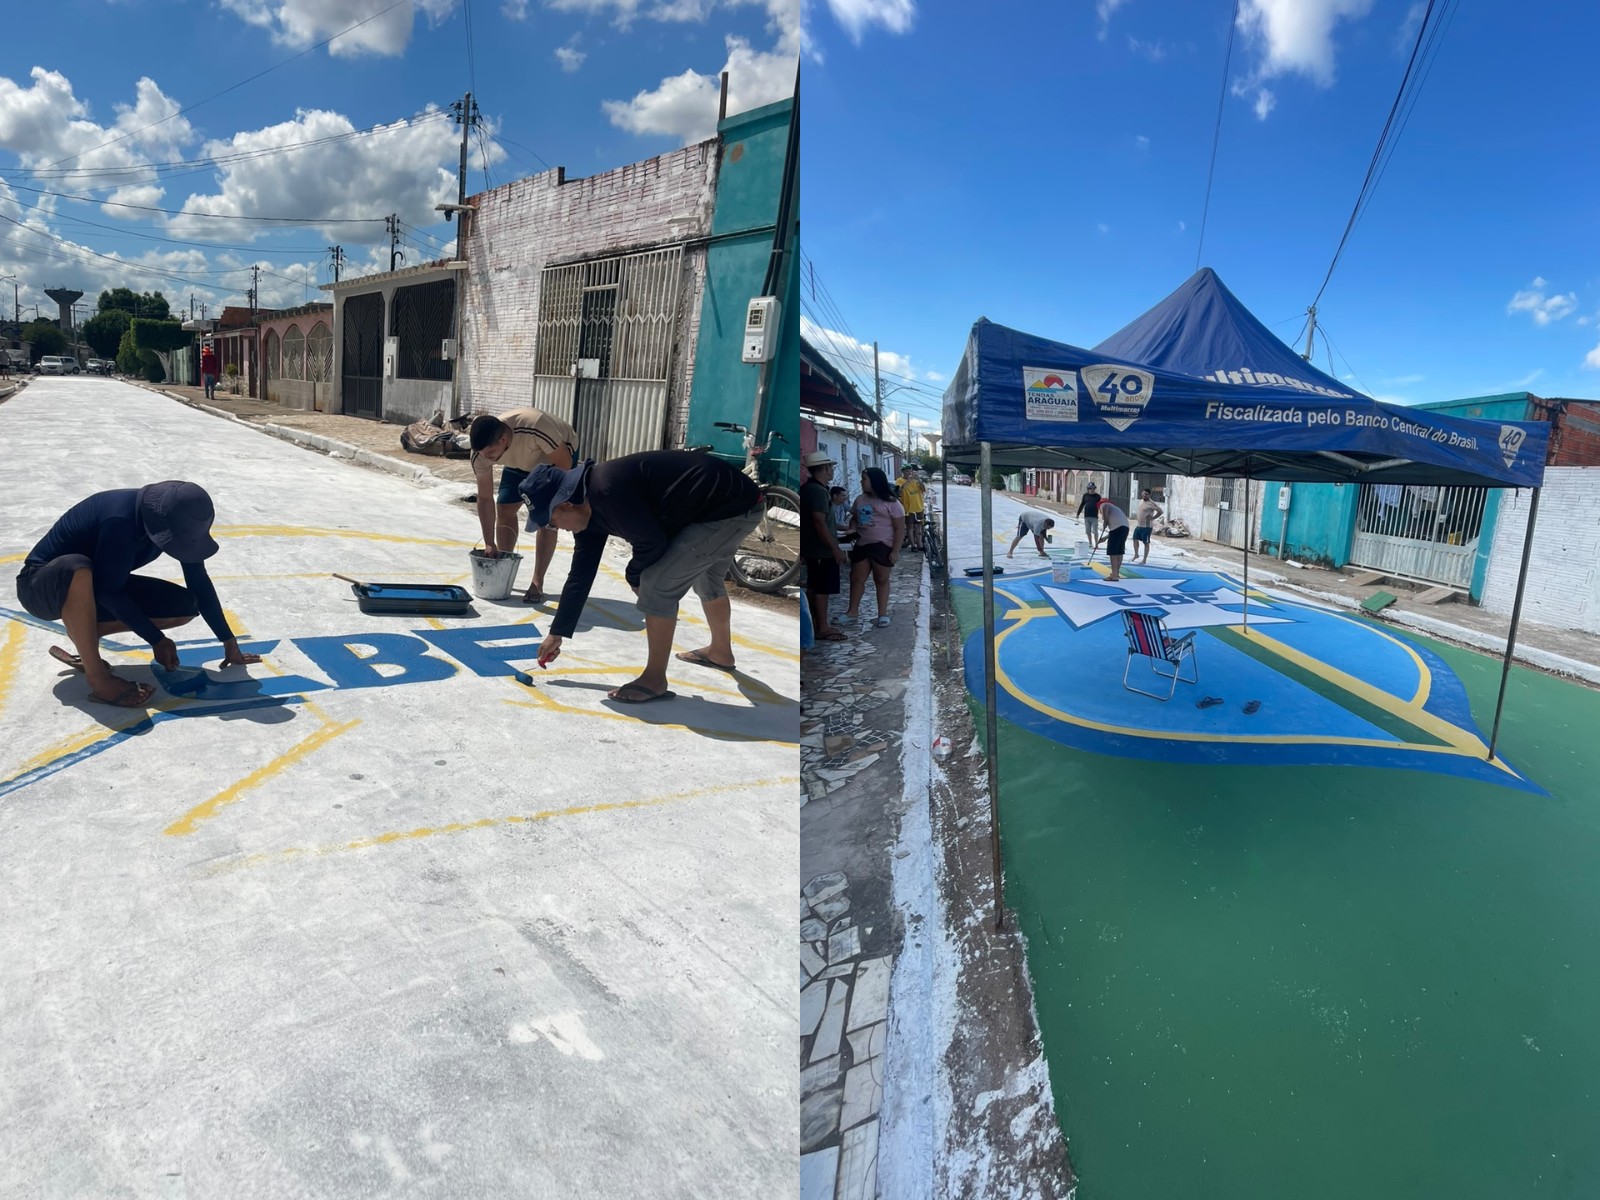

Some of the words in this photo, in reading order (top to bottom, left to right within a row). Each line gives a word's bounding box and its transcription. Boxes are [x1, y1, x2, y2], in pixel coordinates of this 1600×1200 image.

[1097, 372, 1143, 404] 40
[1028, 396, 1077, 406] ARAGUAIA
[1125, 394, 1144, 402] anos
[1205, 401, 1302, 423] Fiscalizada
[1307, 409, 1340, 427] pelo
[1345, 410, 1389, 429] Banco
[1391, 416, 1434, 439] Central
[1431, 429, 1448, 443] do
[1448, 431, 1479, 450] Brasil.
[1108, 592, 1219, 607] CBF
